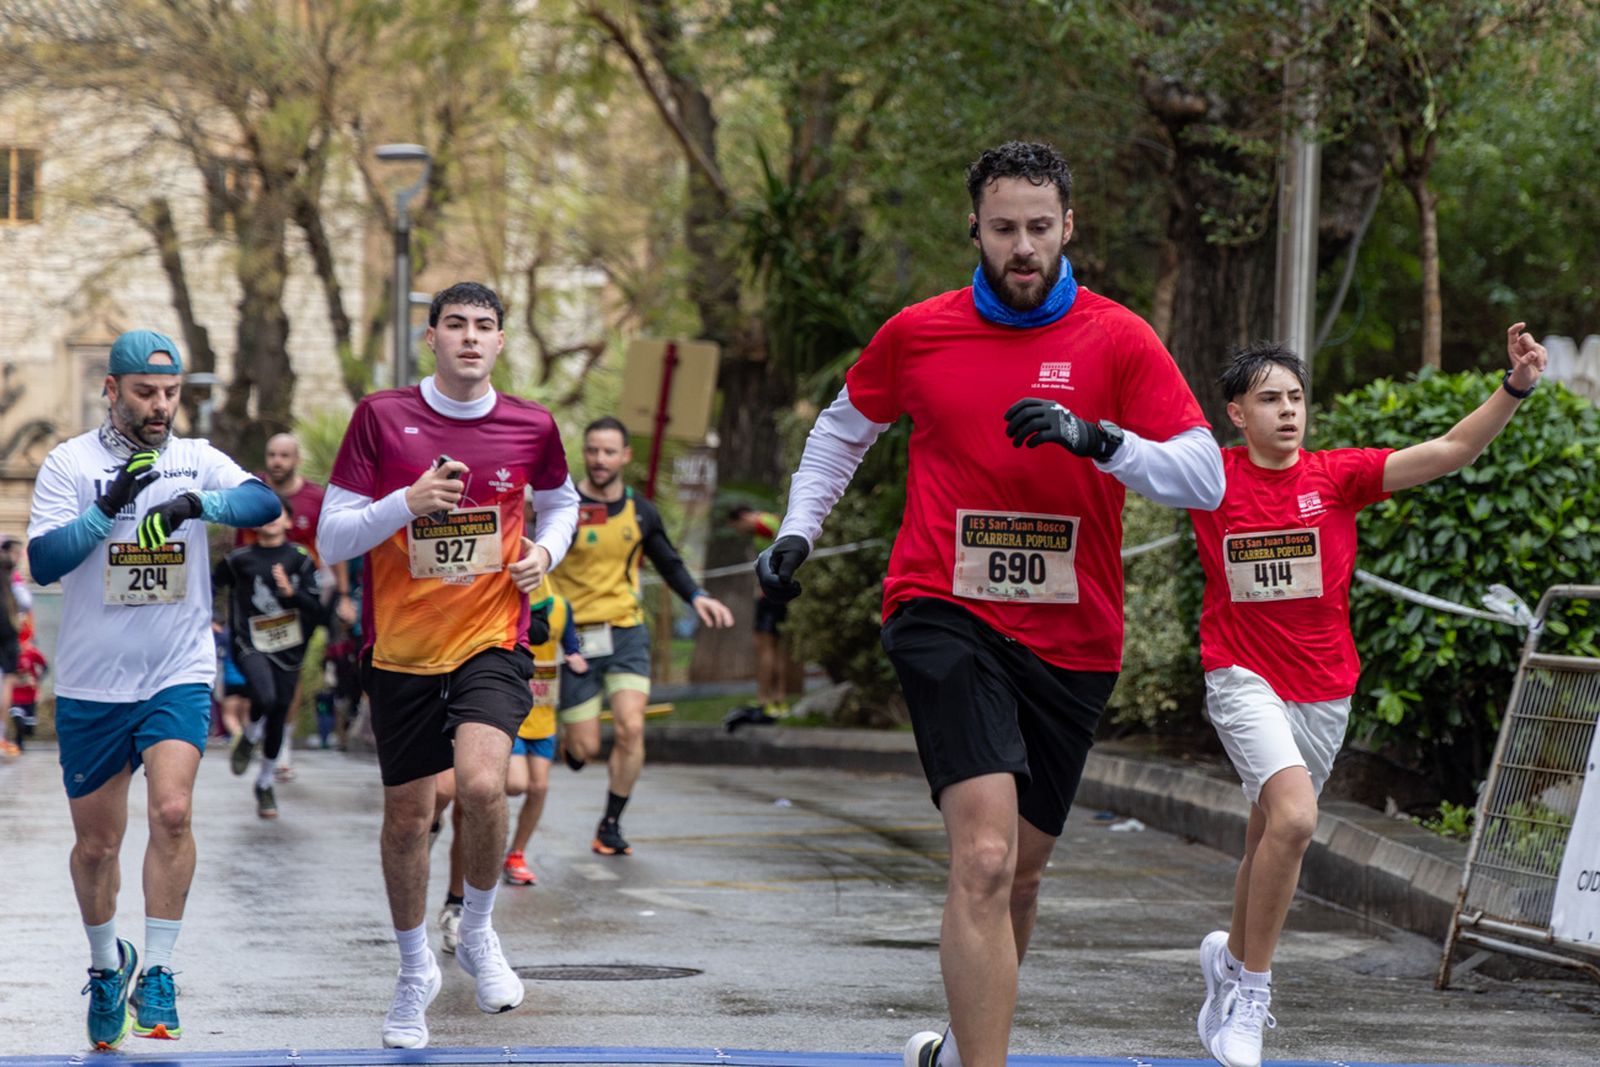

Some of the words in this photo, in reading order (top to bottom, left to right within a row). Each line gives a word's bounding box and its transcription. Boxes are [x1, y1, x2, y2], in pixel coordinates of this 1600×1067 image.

[468, 513, 491, 522] Bosco
[969, 517, 985, 529] IES
[988, 518, 1008, 531] San
[1009, 520, 1035, 532] Juan
[1036, 521, 1066, 533] Bosco
[415, 528, 422, 538] V
[423, 526, 459, 537] CARRERA
[460, 522, 495, 535] POPULAR
[966, 531, 974, 544] V
[975, 531, 1022, 547] CARRERA
[1025, 534, 1068, 549] POPULAR
[1231, 540, 1244, 549] IES
[1246, 539, 1262, 548] San
[1263, 537, 1283, 546] Juan
[1285, 535, 1310, 544] Bosco
[118, 553, 152, 564] CARRERA
[153, 553, 184, 564] POPULAR
[435, 538, 477, 564] 927
[1231, 551, 1237, 560] V
[1238, 547, 1275, 560] CARRERA
[1277, 544, 1314, 557] POPULAR
[989, 551, 1046, 585] 690
[1254, 561, 1292, 587] 414
[128, 567, 167, 591] 204
